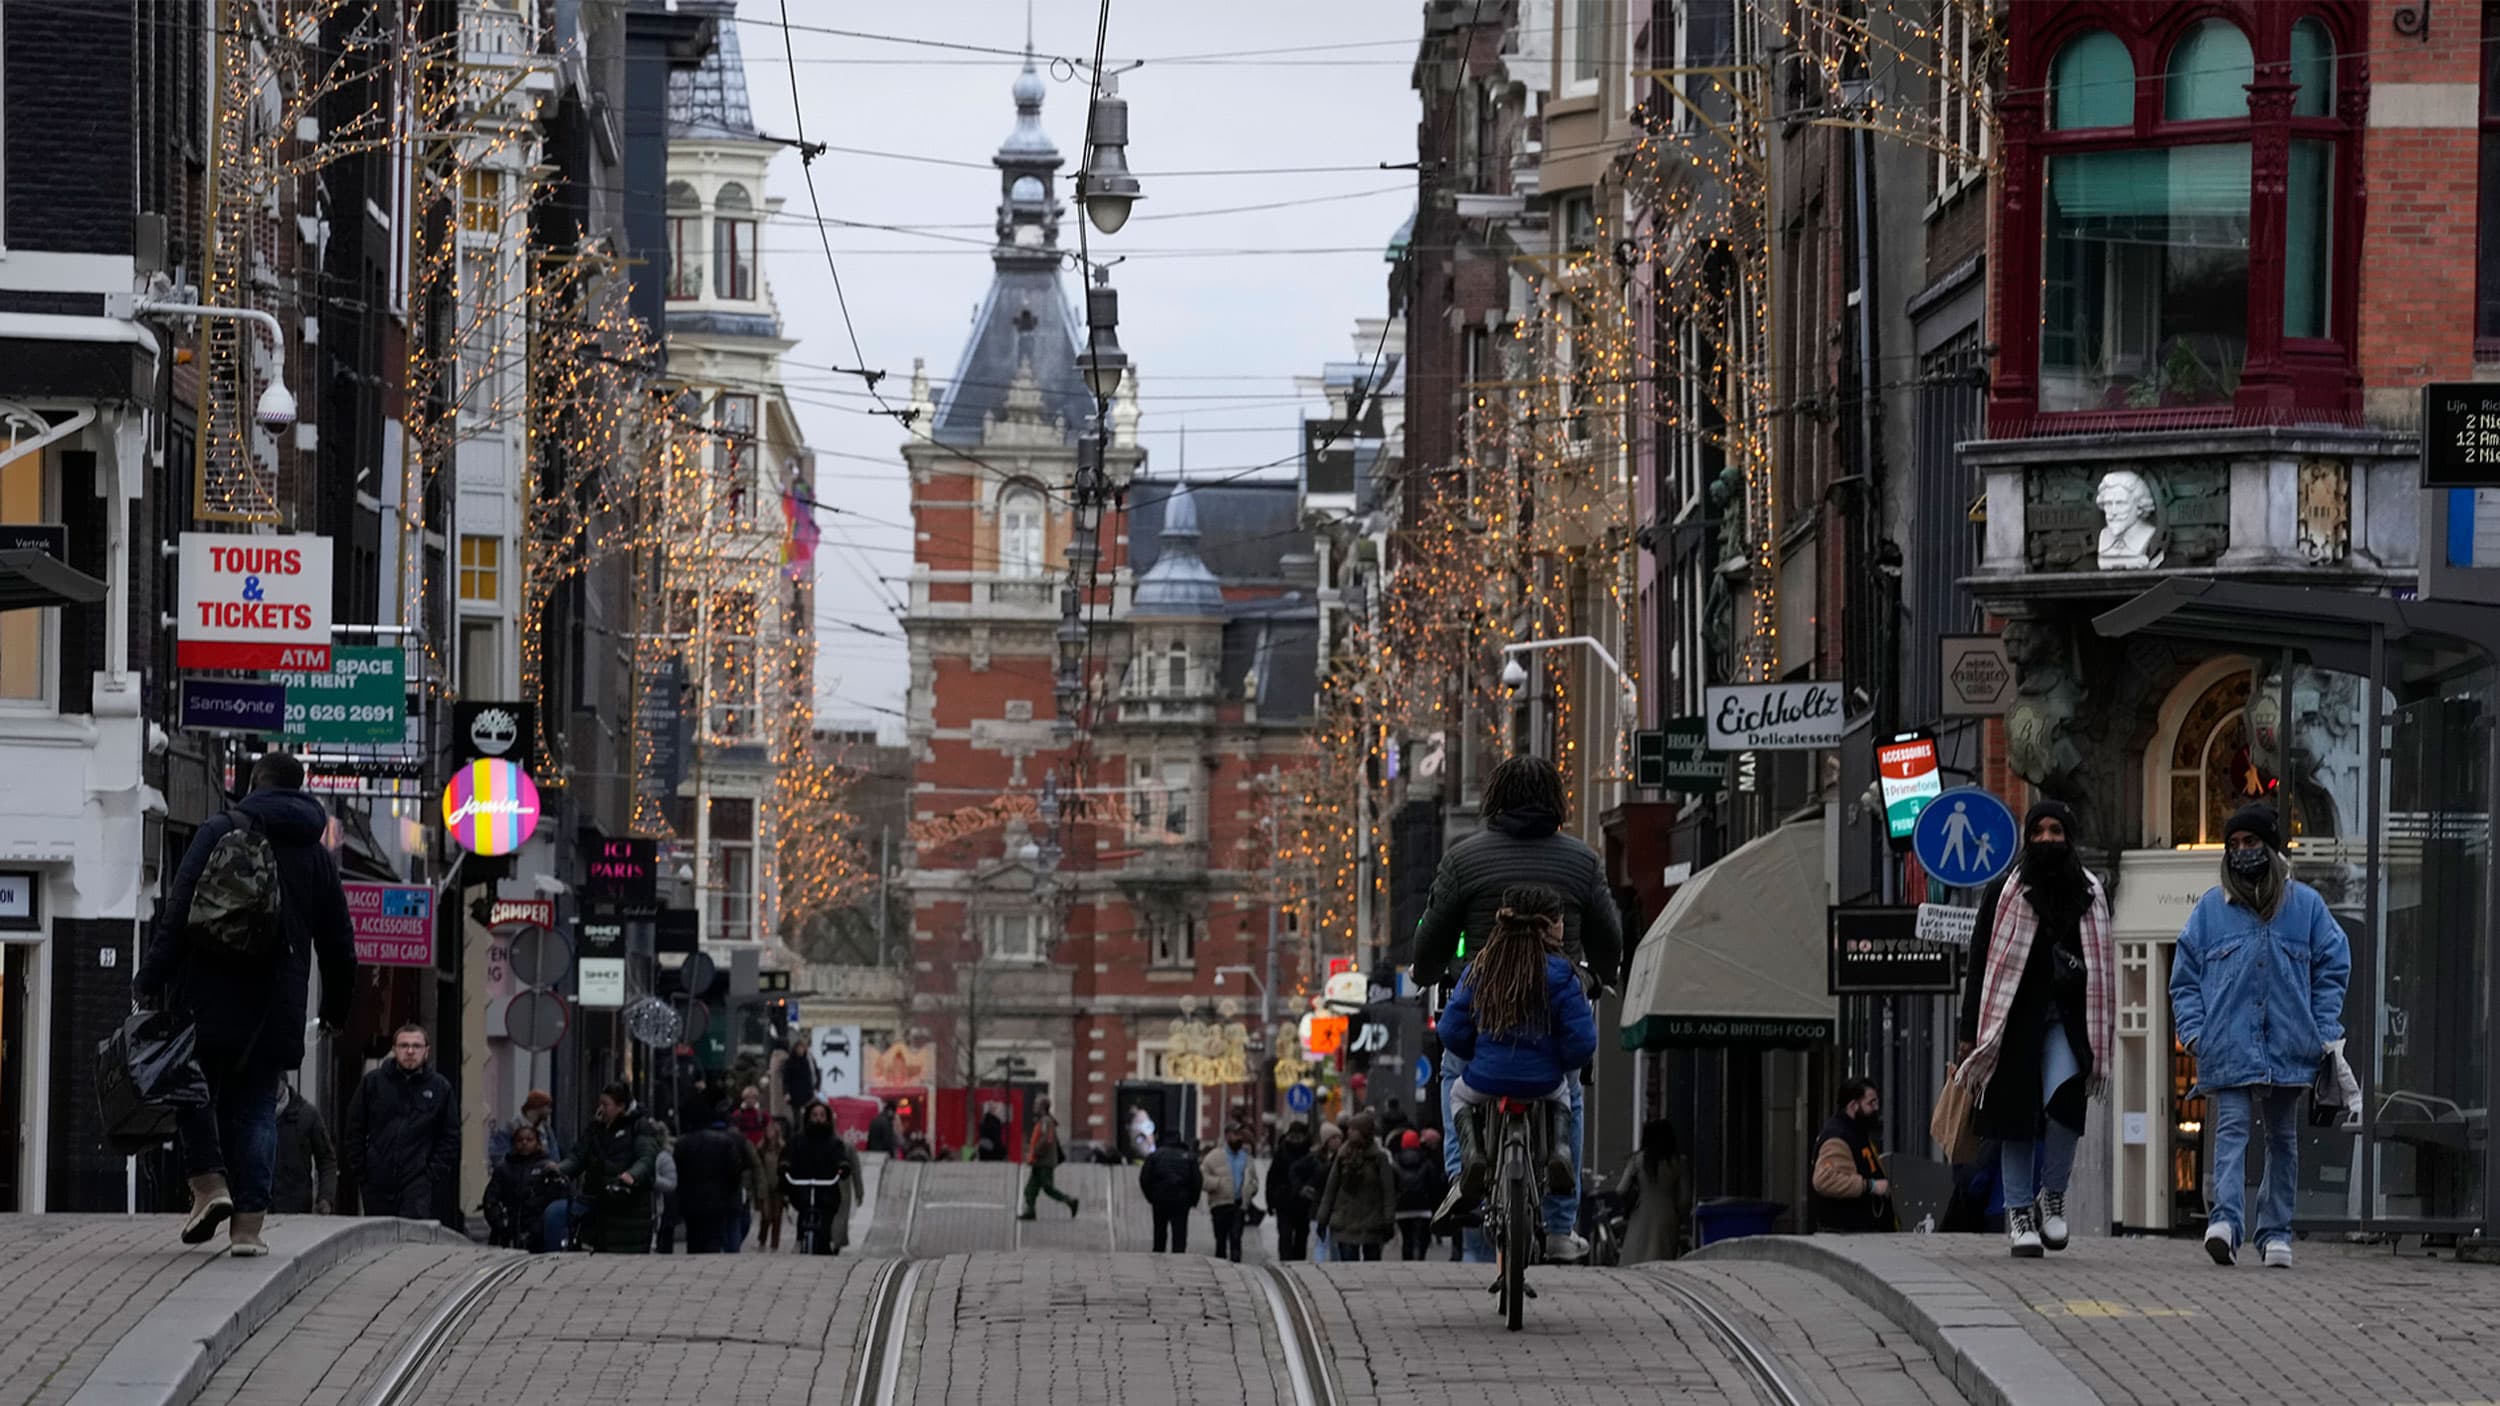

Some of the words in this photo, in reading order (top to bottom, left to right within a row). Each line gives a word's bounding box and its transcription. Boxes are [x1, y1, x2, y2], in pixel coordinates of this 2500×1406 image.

[2447, 400, 2468, 414] Lijn
[2466, 414, 2476, 429] 2
[2456, 431, 2476, 446] 12
[2480, 431, 2499, 446] Am
[2465, 448, 2475, 463] 2
[209, 547, 302, 575] TOURS
[242, 575, 264, 601] &
[197, 602, 312, 630] TICKETS
[280, 649, 325, 667] ATM
[335, 659, 394, 675] SPACE
[270, 673, 306, 689] FOR
[310, 674, 358, 689] RENT
[190, 697, 275, 715] Samsonite
[284, 704, 306, 721] 20
[310, 705, 346, 721] 626
[349, 705, 395, 721] 2691
[1716, 686, 1839, 735] Eichholtz
[1748, 733, 1841, 746] Delicatessen
[604, 843, 632, 857] ICI
[591, 862, 644, 878] PARIS
[490, 903, 550, 926] CAMPER
[1927, 907, 1975, 921] Uitgezonder
[361, 918, 423, 937] ACCESSORIES
[1958, 921, 1972, 934] Los
[354, 942, 379, 959] RNET
[380, 943, 399, 960] SIM
[400, 944, 428, 961] CARD
[1848, 953, 1884, 962] TATTOO
[1897, 953, 1942, 961] PIERCING
[1670, 1022, 1694, 1035] U.S.
[1700, 1023, 1728, 1035] AND
[1731, 1024, 1783, 1037] BRITISH
[1787, 1026, 1825, 1038] FOOD
